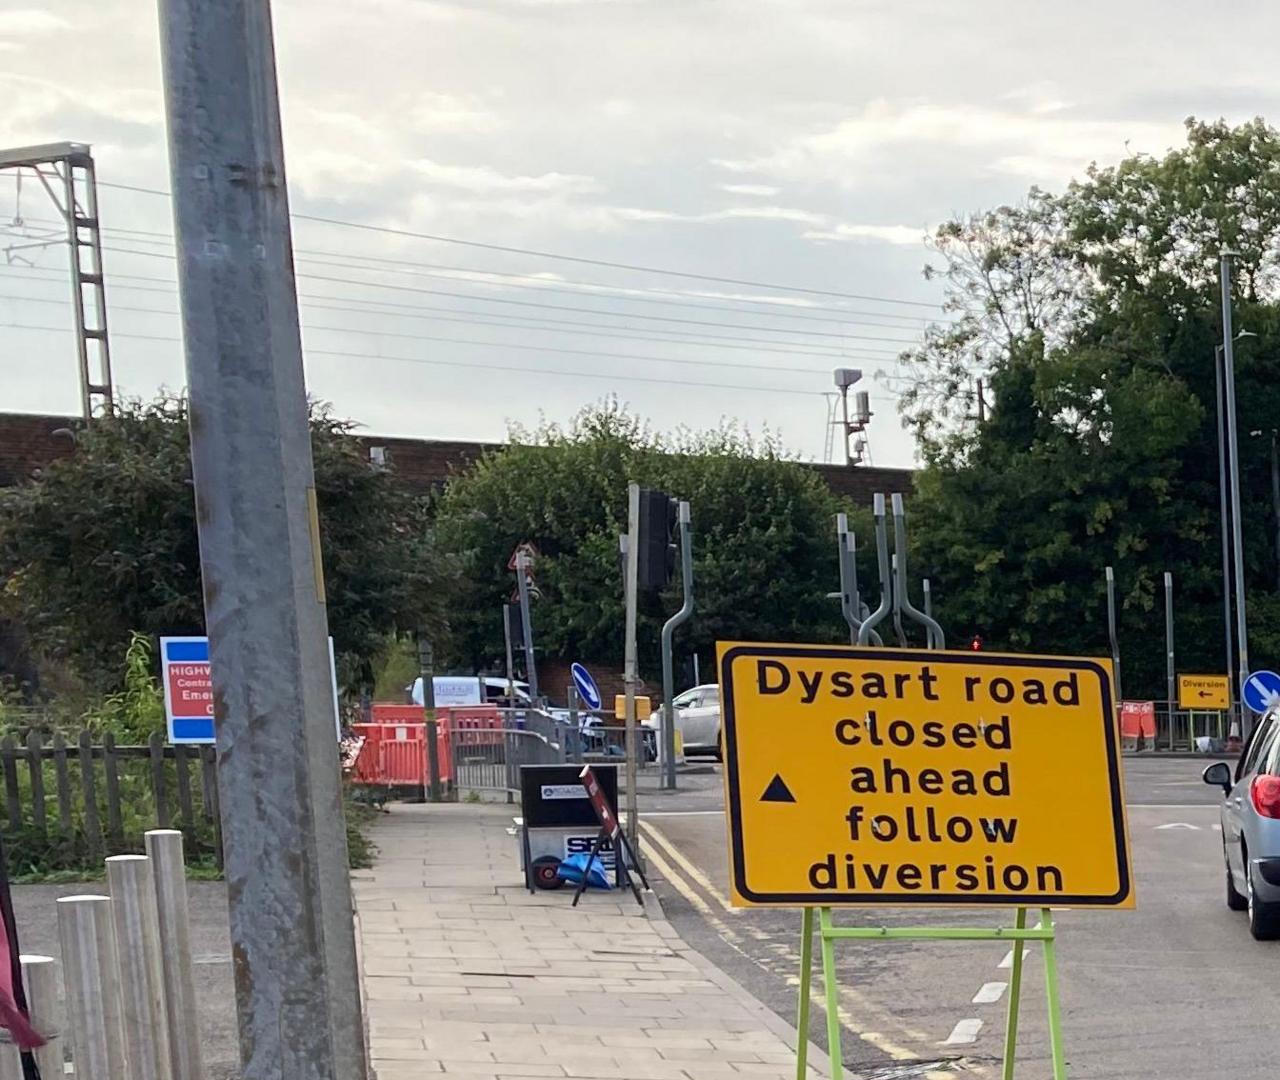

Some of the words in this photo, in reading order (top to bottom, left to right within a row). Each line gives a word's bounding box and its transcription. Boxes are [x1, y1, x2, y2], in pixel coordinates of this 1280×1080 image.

[757, 660, 938, 704] Dysart
[965, 672, 1079, 705] road
[1182, 679, 1226, 688] Diversion
[836, 711, 1011, 749] closed
[851, 759, 1010, 796] ahead
[846, 806, 1017, 843] follow
[809, 854, 1062, 891] diversion
